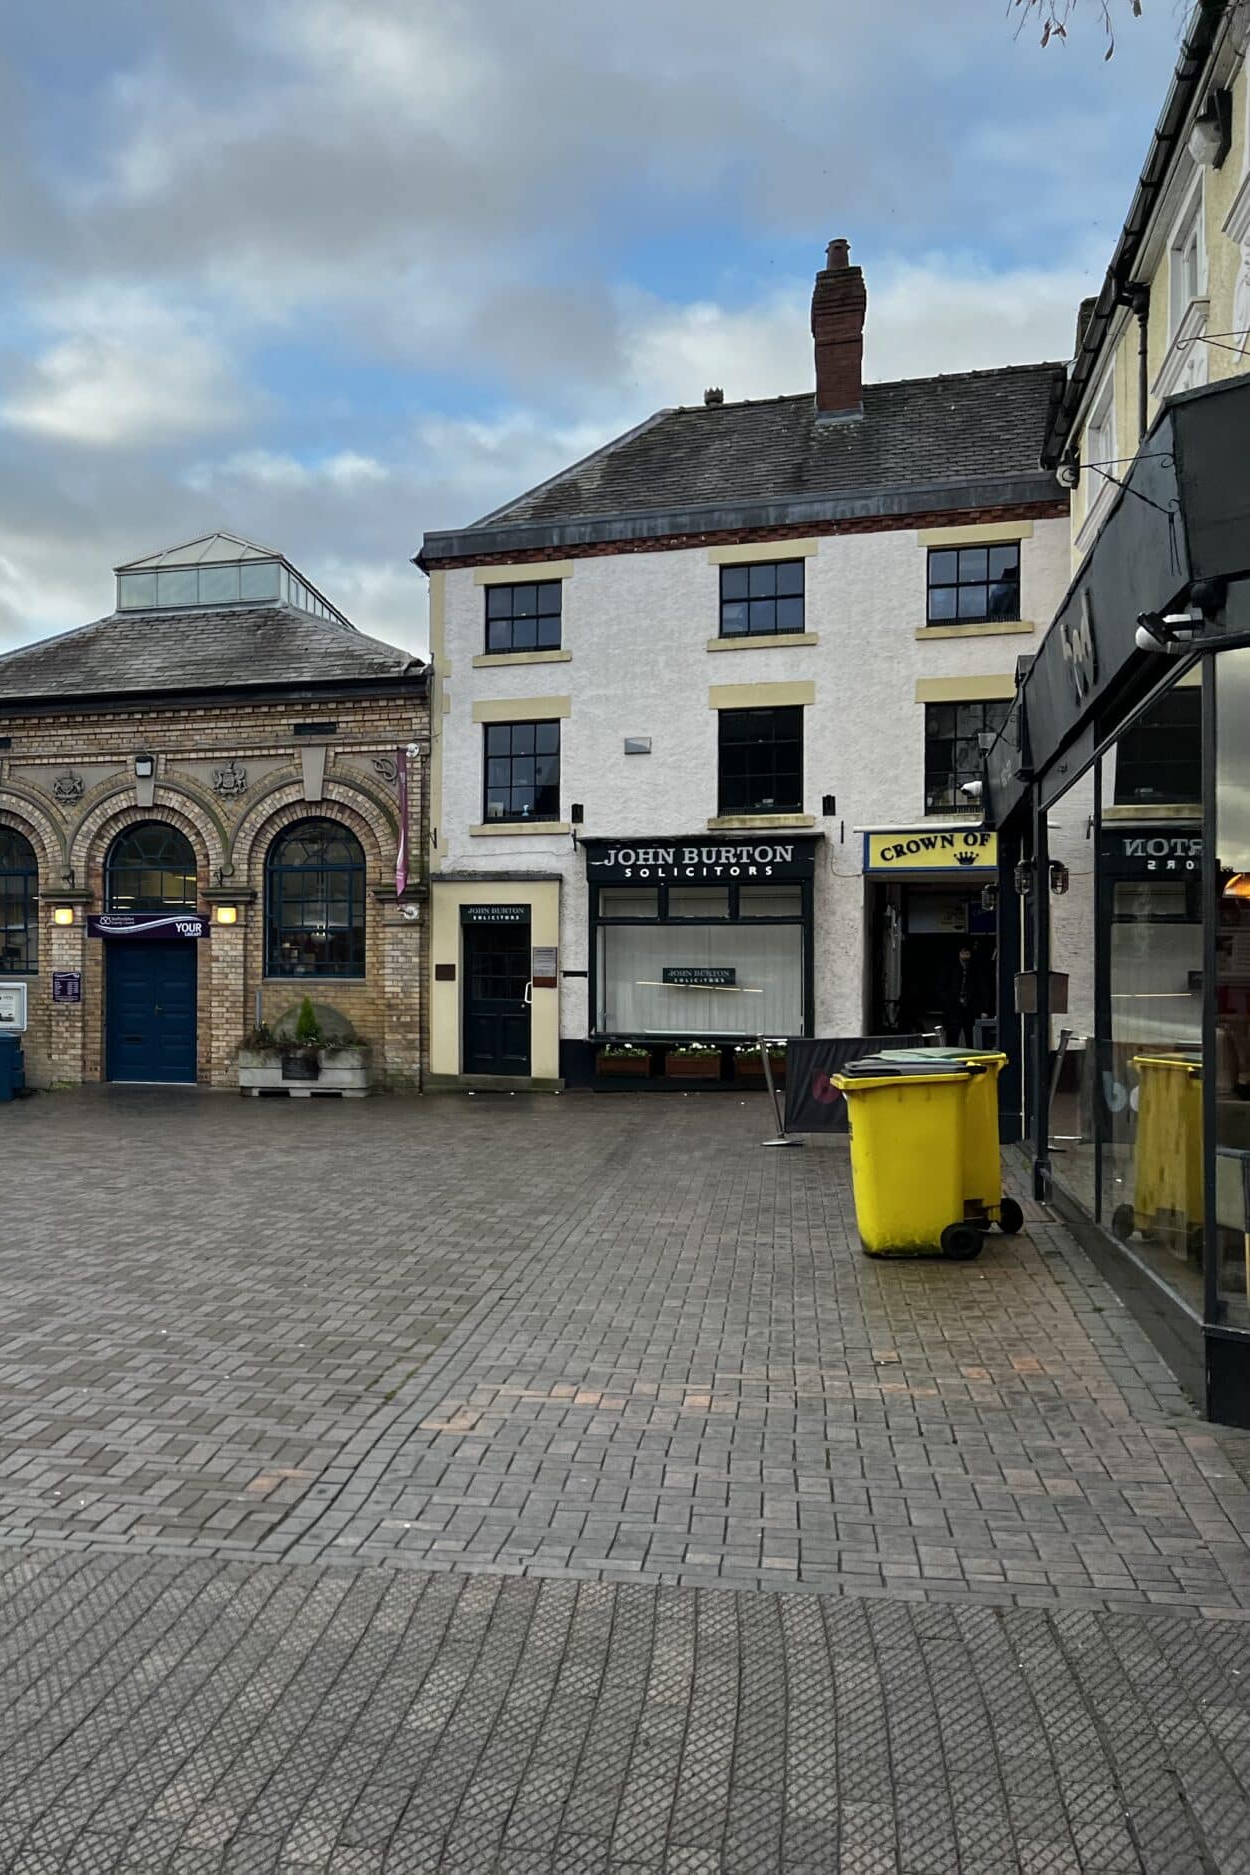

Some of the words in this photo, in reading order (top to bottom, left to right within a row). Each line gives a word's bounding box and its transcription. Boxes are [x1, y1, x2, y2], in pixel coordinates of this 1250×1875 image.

[880, 834, 955, 862] CROWN
[963, 832, 991, 847] OF
[604, 848, 676, 866] JOHN
[682, 846, 795, 864] BURTON
[625, 866, 774, 878] SOLICITORS
[175, 922, 203, 933] YOUR
[668, 969, 692, 977] JOHN
[694, 969, 730, 977] BURTON
